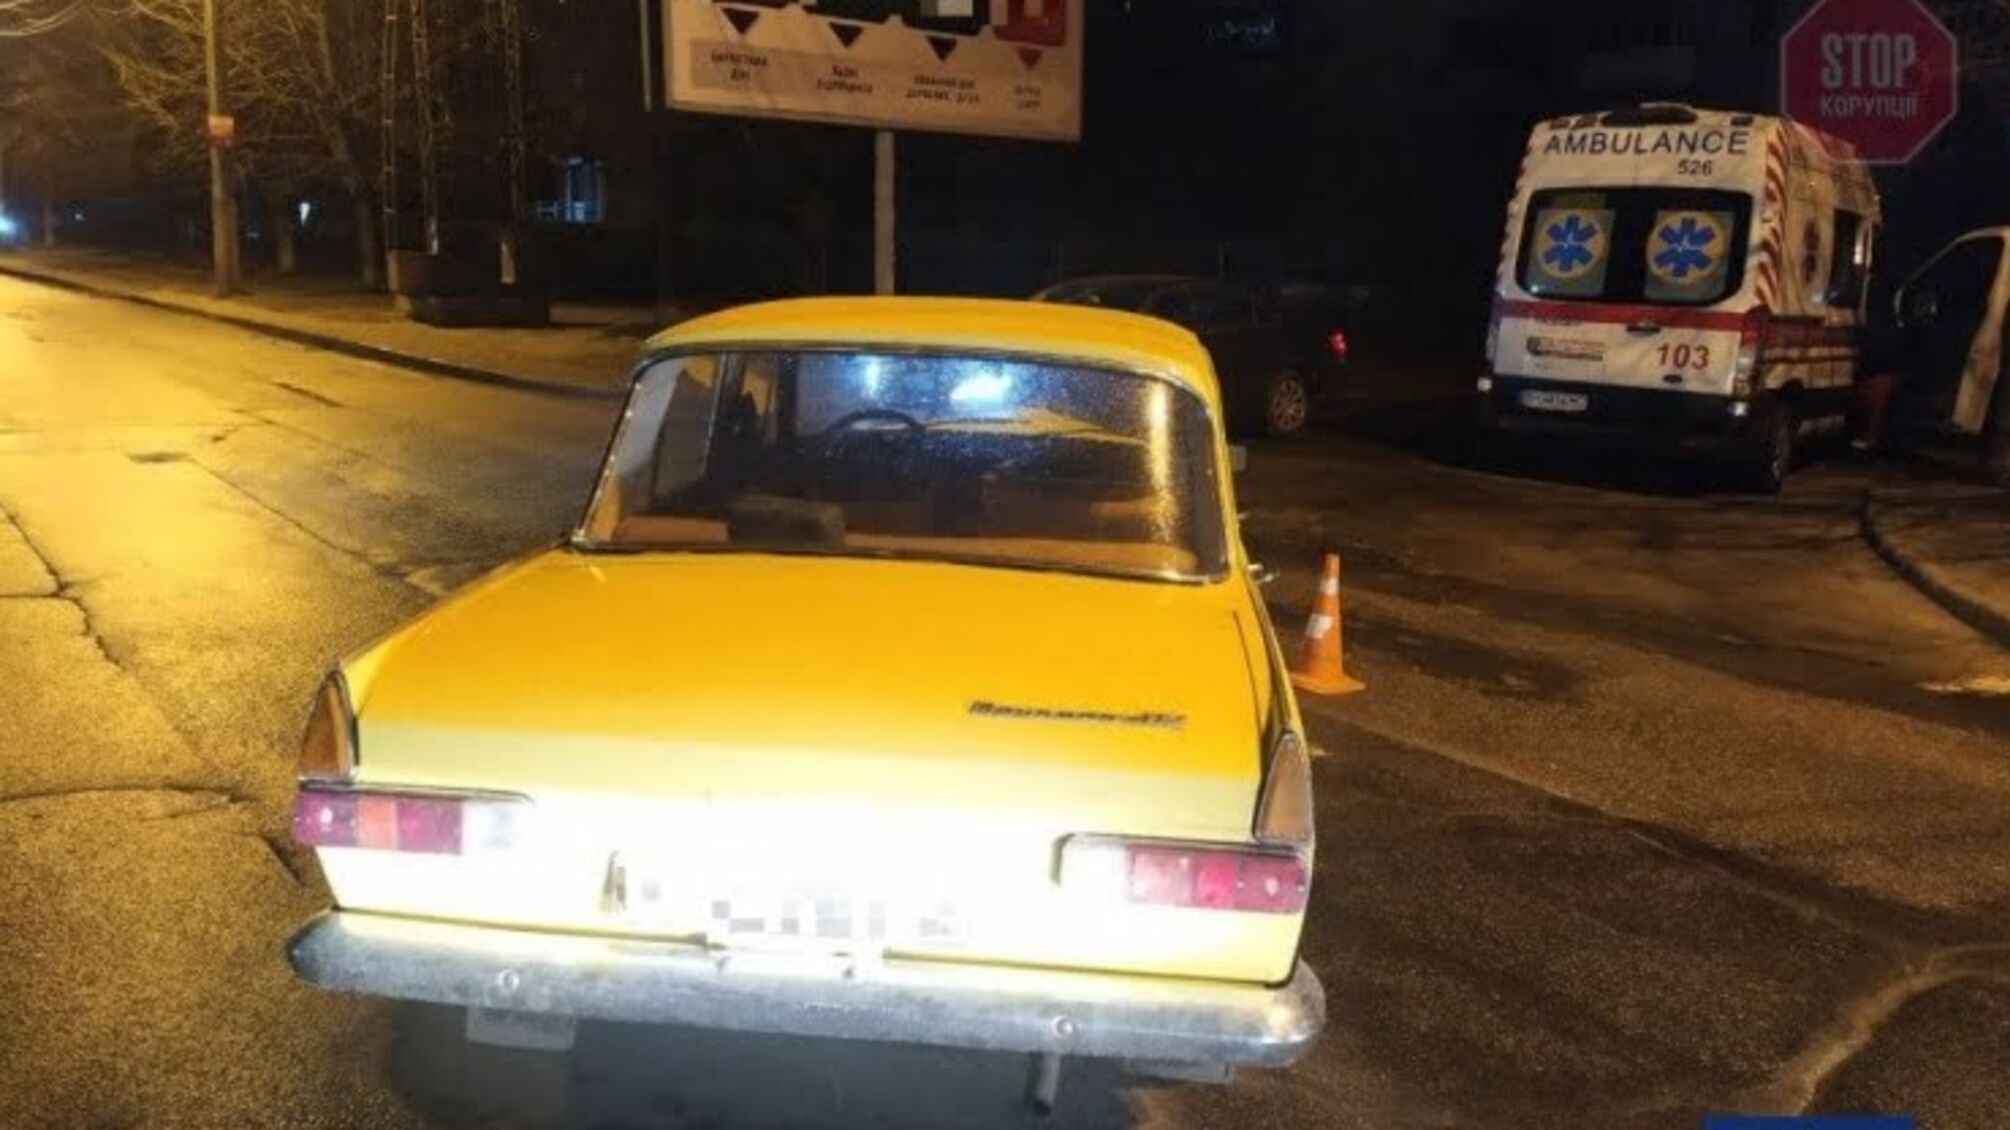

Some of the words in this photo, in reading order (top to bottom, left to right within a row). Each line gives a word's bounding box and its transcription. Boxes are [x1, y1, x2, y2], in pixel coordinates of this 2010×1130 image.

[1544, 129, 1750, 157] AMBULANCE
[1677, 159, 1713, 176] 526
[1656, 342, 1710, 371] 103
